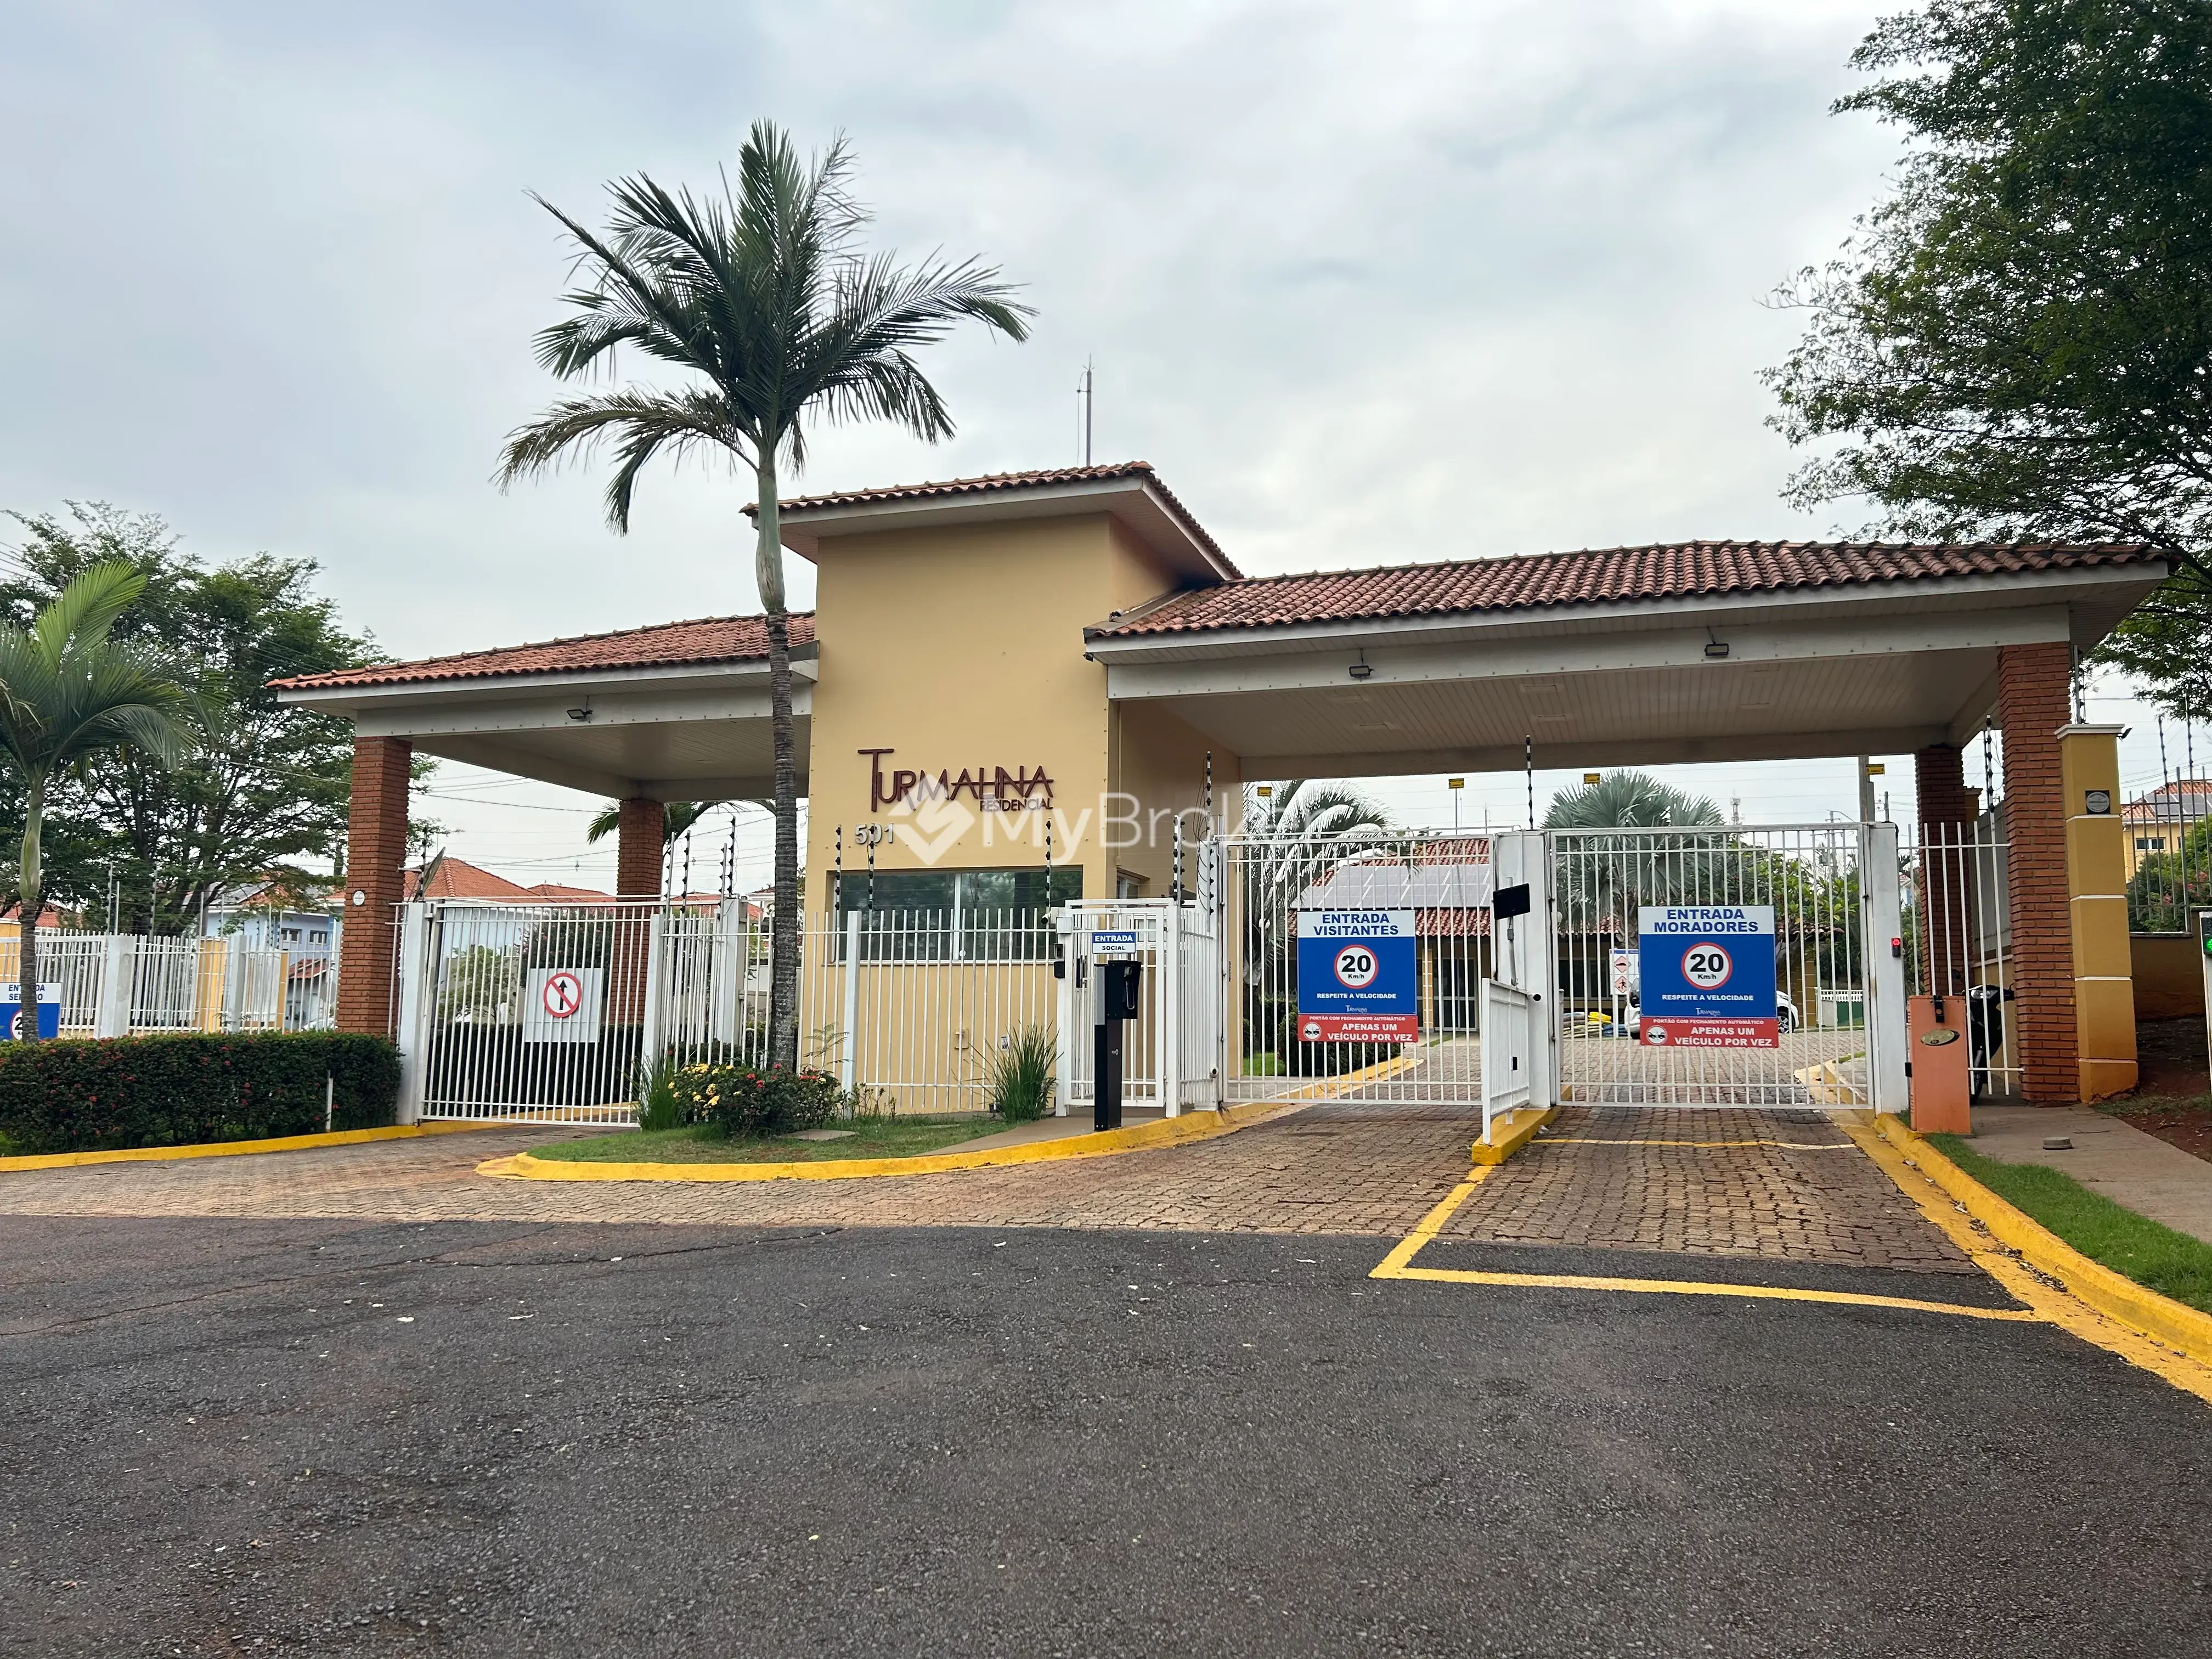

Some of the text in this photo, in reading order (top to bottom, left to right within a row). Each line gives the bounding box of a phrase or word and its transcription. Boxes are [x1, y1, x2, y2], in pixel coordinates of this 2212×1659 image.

[980, 797, 1053, 811] RESIDENCIAL
[854, 823, 894, 844] 501
[1322, 913, 1390, 924] ENTRADA
[1667, 909, 1745, 919] ENTRADA
[1313, 925, 1398, 935] VISITANTES
[1654, 921, 1759, 933] MORADORES
[1341, 955, 1371, 973] 20
[1690, 953, 1724, 972] 20
[1691, 1026, 1754, 1035] APENAS UM
[1328, 1032, 1369, 1041] VEÍCULO
[1372, 1033, 1391, 1041] POR
[1674, 1036, 1772, 1047] VEÍCULO POR VEZ
